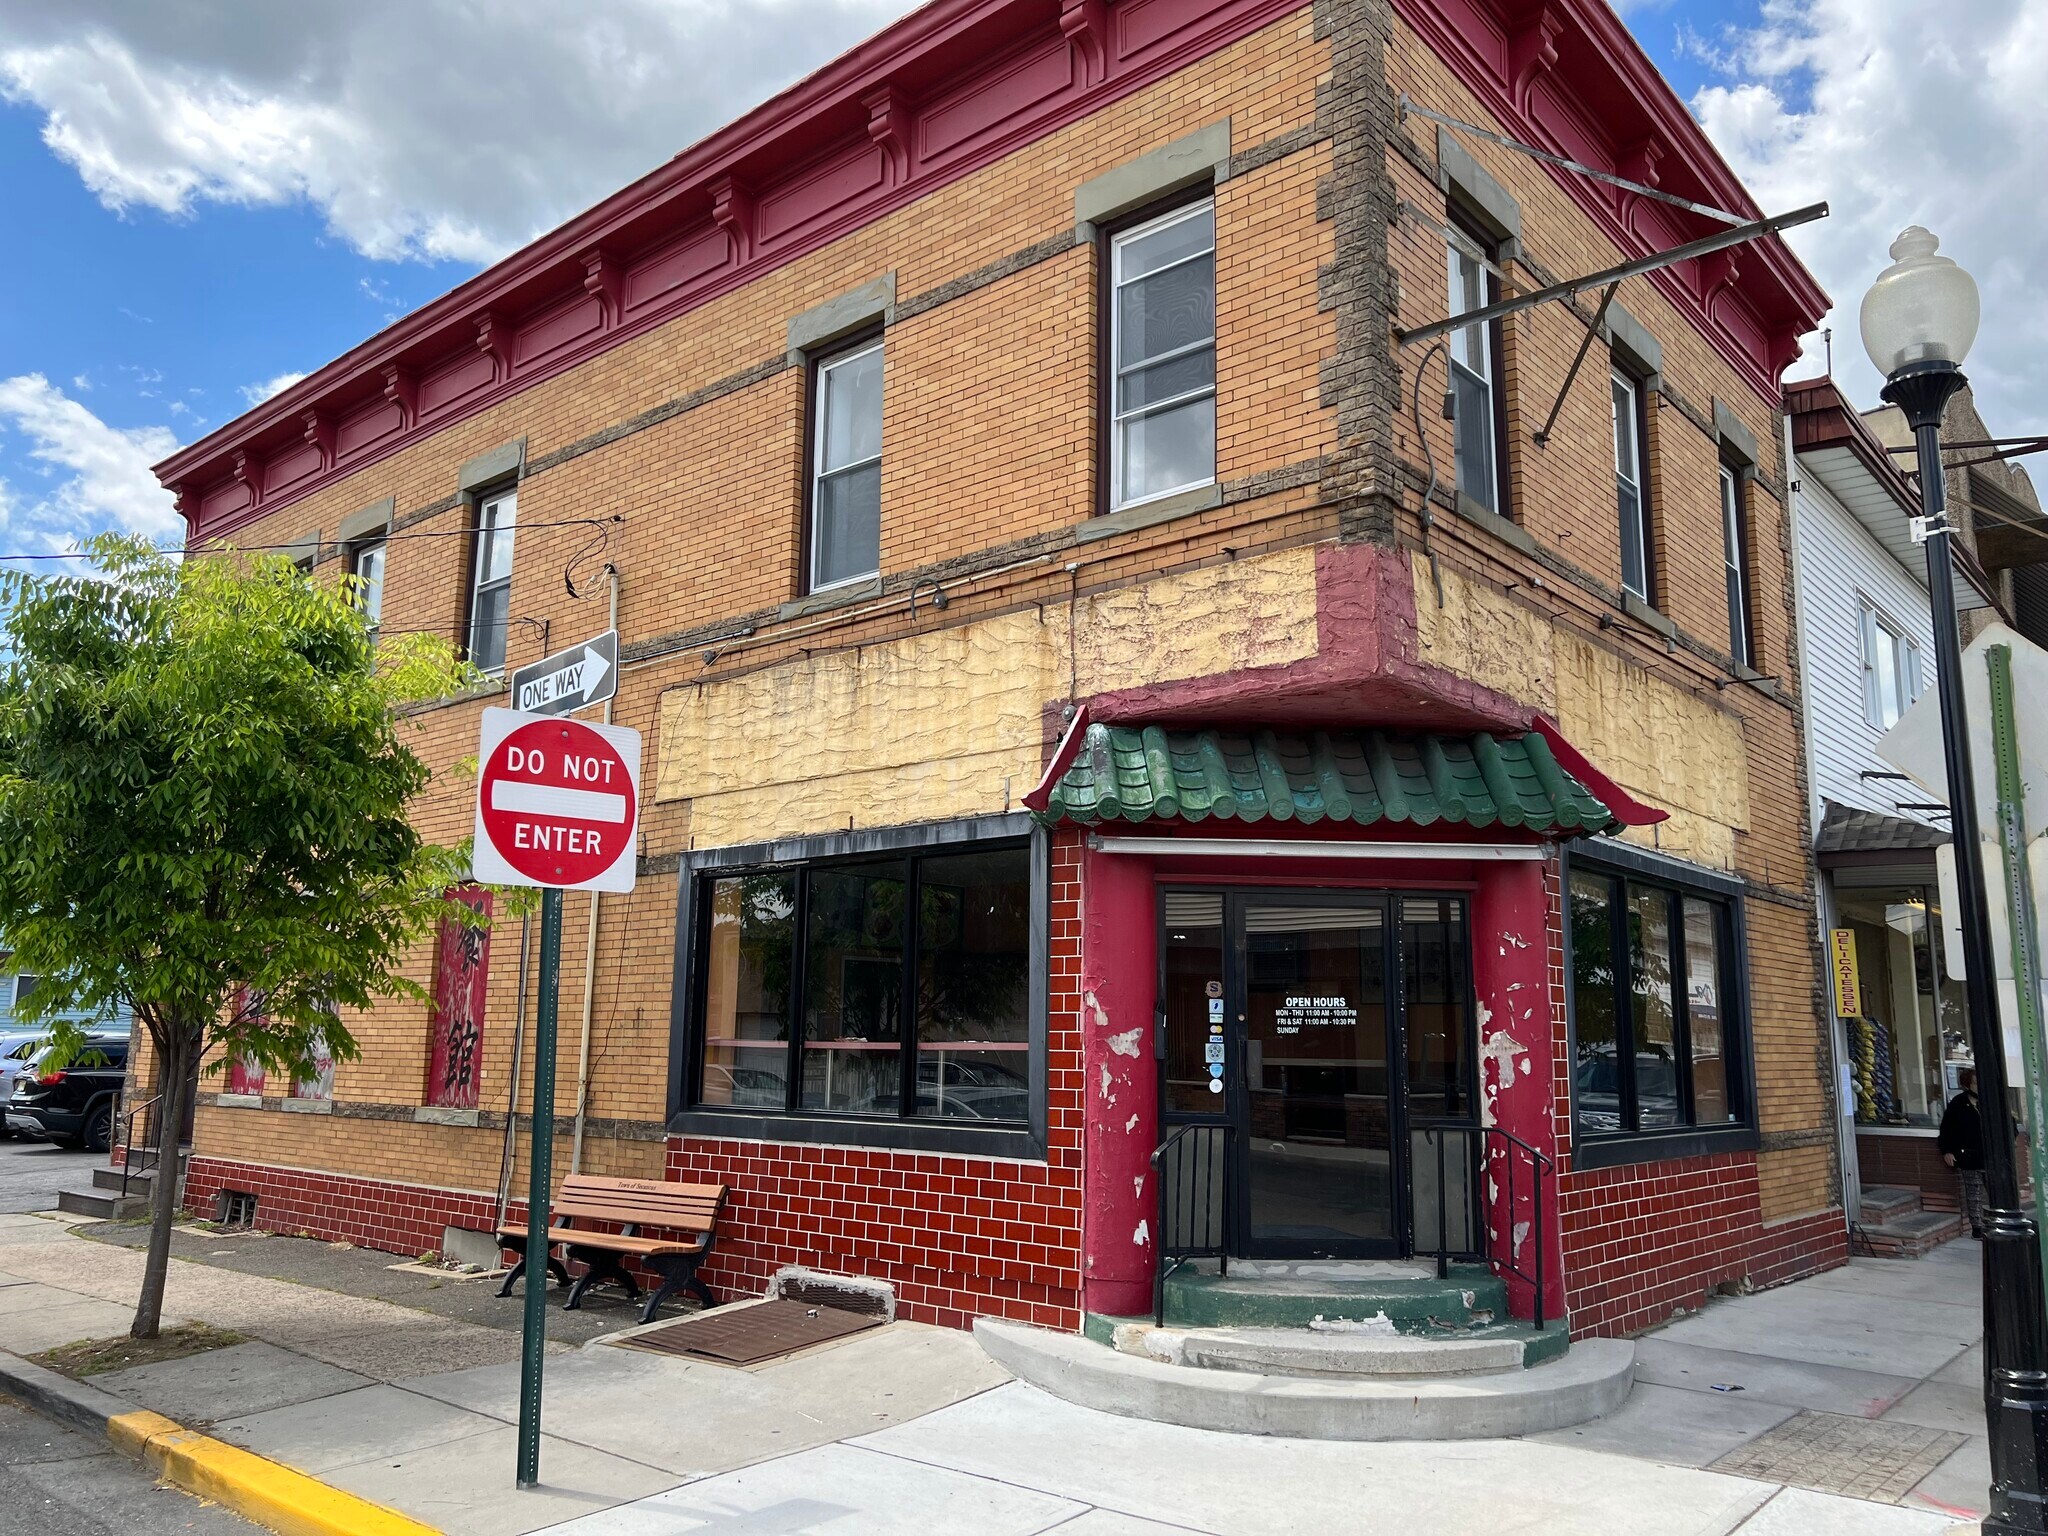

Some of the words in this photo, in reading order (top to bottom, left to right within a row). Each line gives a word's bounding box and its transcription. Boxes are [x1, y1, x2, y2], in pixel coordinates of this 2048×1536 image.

[523, 684, 550, 710] ONE
[555, 663, 585, 697] WAY
[507, 746, 545, 775] DO
[563, 754, 615, 784] NOT
[514, 823, 602, 855] ENTER
[1836, 931, 1857, 1014] DELICATESSEN
[1275, 1009, 1289, 1017] MON
[1292, 1009, 1304, 1017] THU
[1306, 1009, 1320, 1017] 11:00
[1321, 1009, 1330, 1017] AM
[1334, 1009, 1348, 1017] 10:00
[1348, 1009, 1357, 1017] PM
[1285, 997, 1311, 1007] OPEN
[1313, 997, 1346, 1007] HOURS
